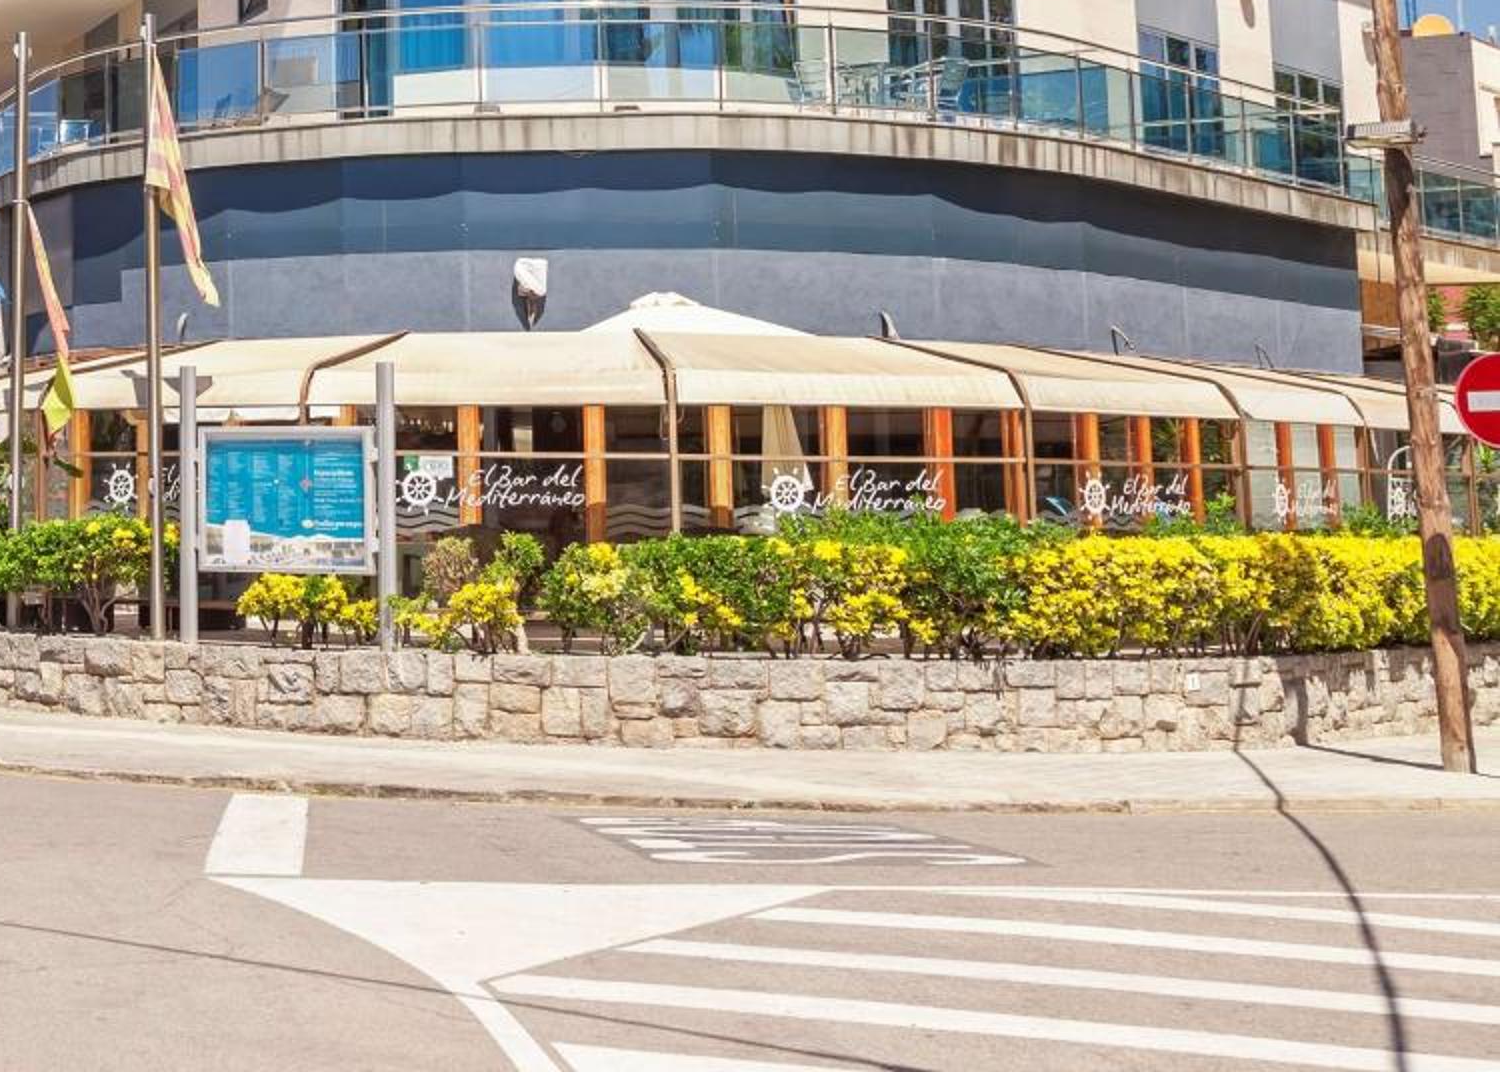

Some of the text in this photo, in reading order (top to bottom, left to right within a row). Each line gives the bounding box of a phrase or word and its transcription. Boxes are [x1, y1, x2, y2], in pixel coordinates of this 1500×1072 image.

[469, 463, 495, 487] El
[498, 464, 537, 489] Bar
[542, 463, 583, 487] del
[836, 465, 944, 492] El Bar del
[444, 483, 585, 509] Mediterráneo
[578, 816, 1029, 865] STOP
